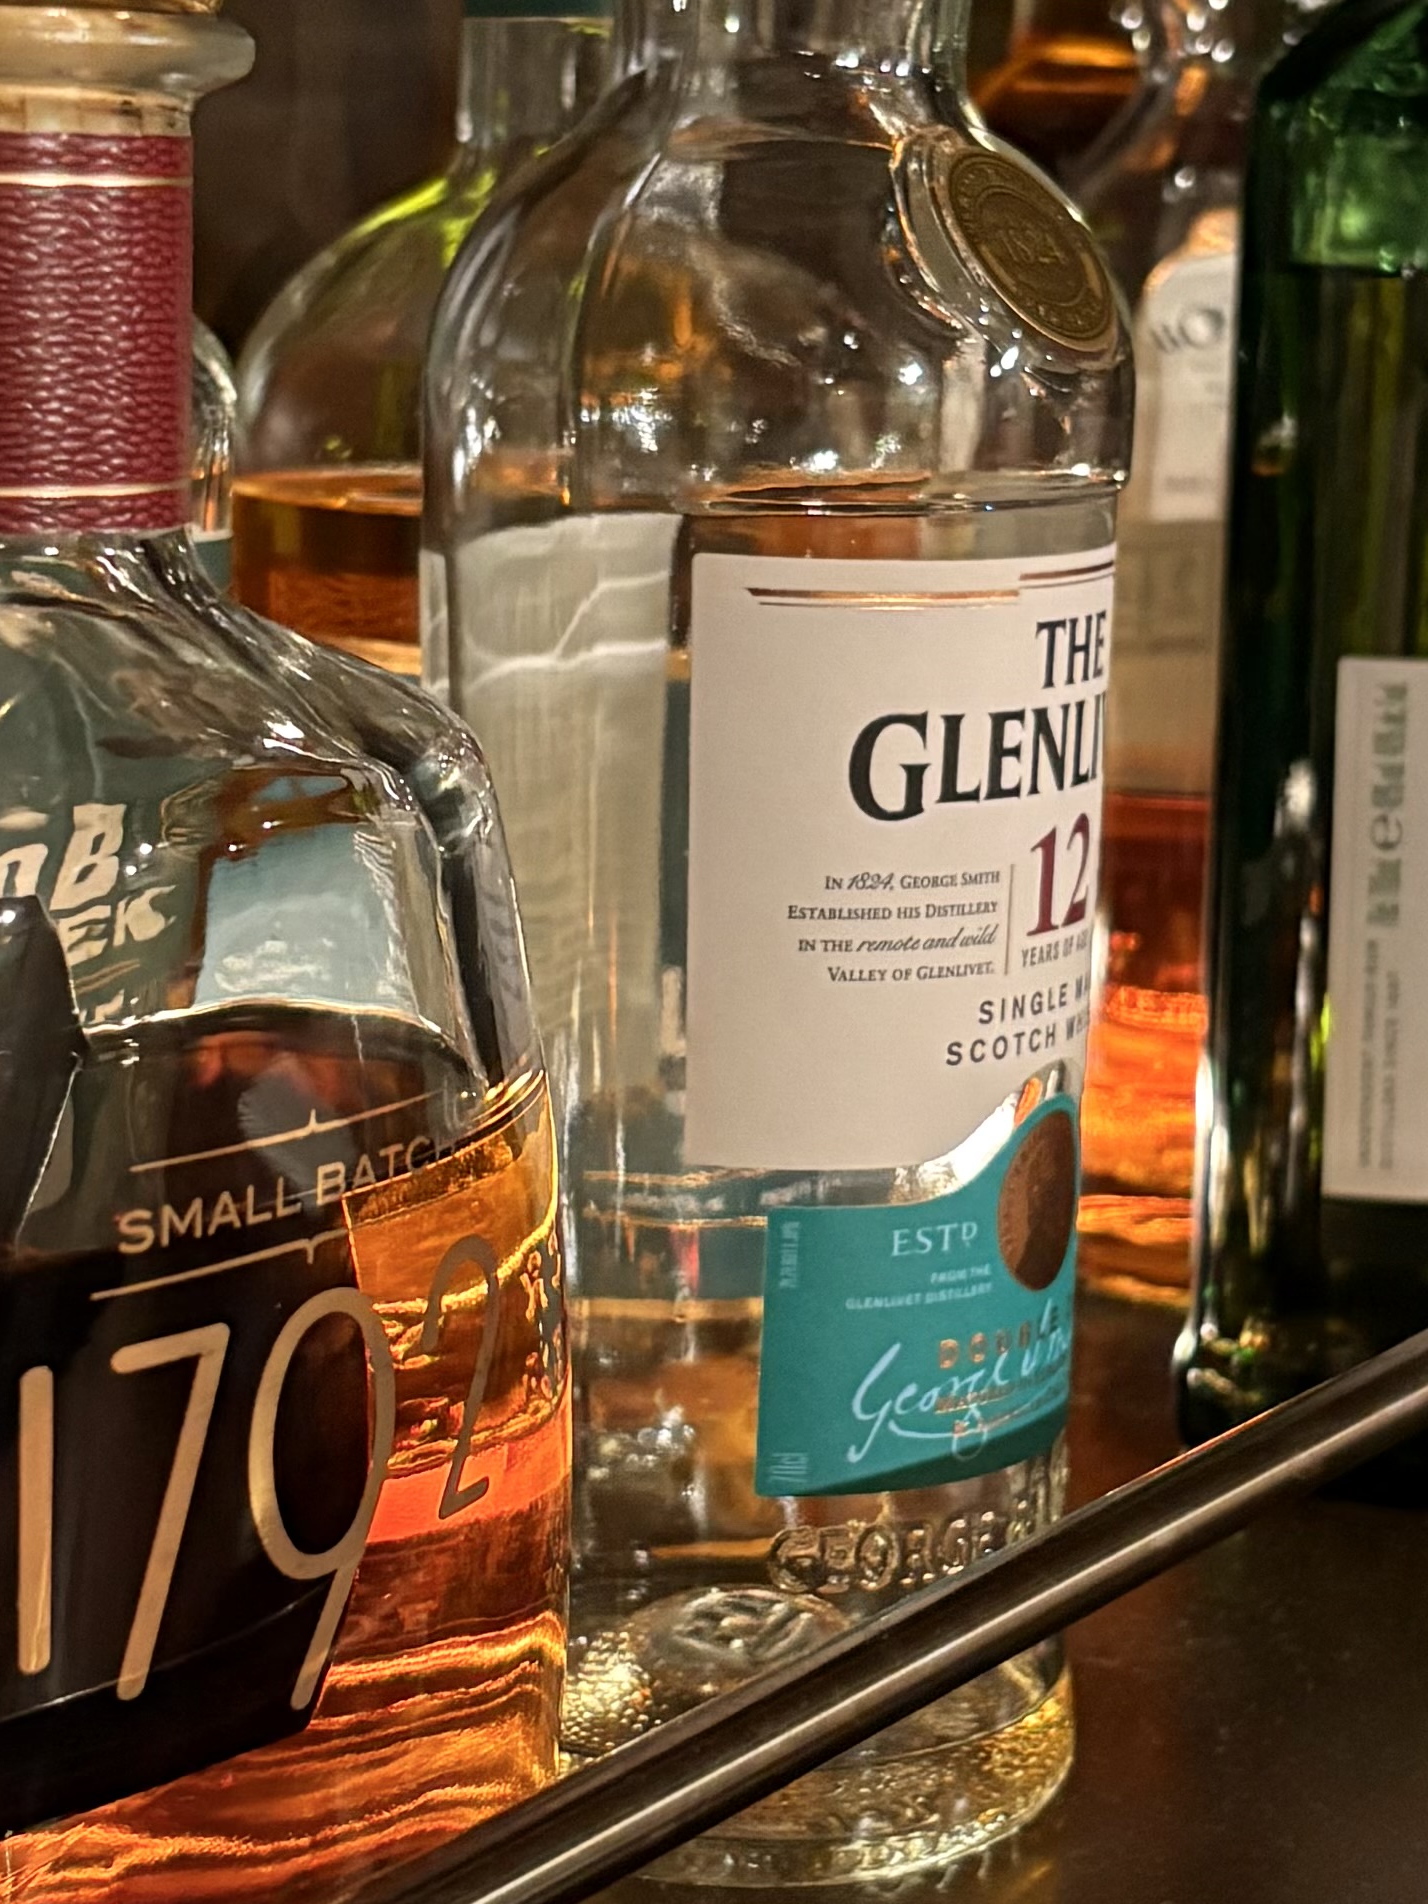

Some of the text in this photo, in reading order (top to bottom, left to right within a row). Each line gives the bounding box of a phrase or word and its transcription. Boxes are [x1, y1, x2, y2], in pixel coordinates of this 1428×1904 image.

[1035, 610, 1107, 689] THE
[848, 691, 1106, 823] GLENLI
[900, 872, 958, 890] GEORGE
[960, 870, 1001, 886] SMITH
[1026, 812, 1091, 937] 12
[787, 900, 999, 921] ESTABLISHED HIS DISTILLERY
[820, 938, 854, 953] THE
[855, 935, 921, 953] remote
[922, 927, 964, 951] and
[959, 923, 1000, 947] wild
[1021, 941, 1060, 968] YEARS
[827, 965, 888, 983] VALLEY
[891, 966, 913, 982] OF
[978, 981, 1070, 1025] SINGLE
[945, 1022, 1057, 1067] SCOTCH
[118, 1130, 460, 1256] SMALL BATCH
[19, 1233, 501, 1712] 1792
